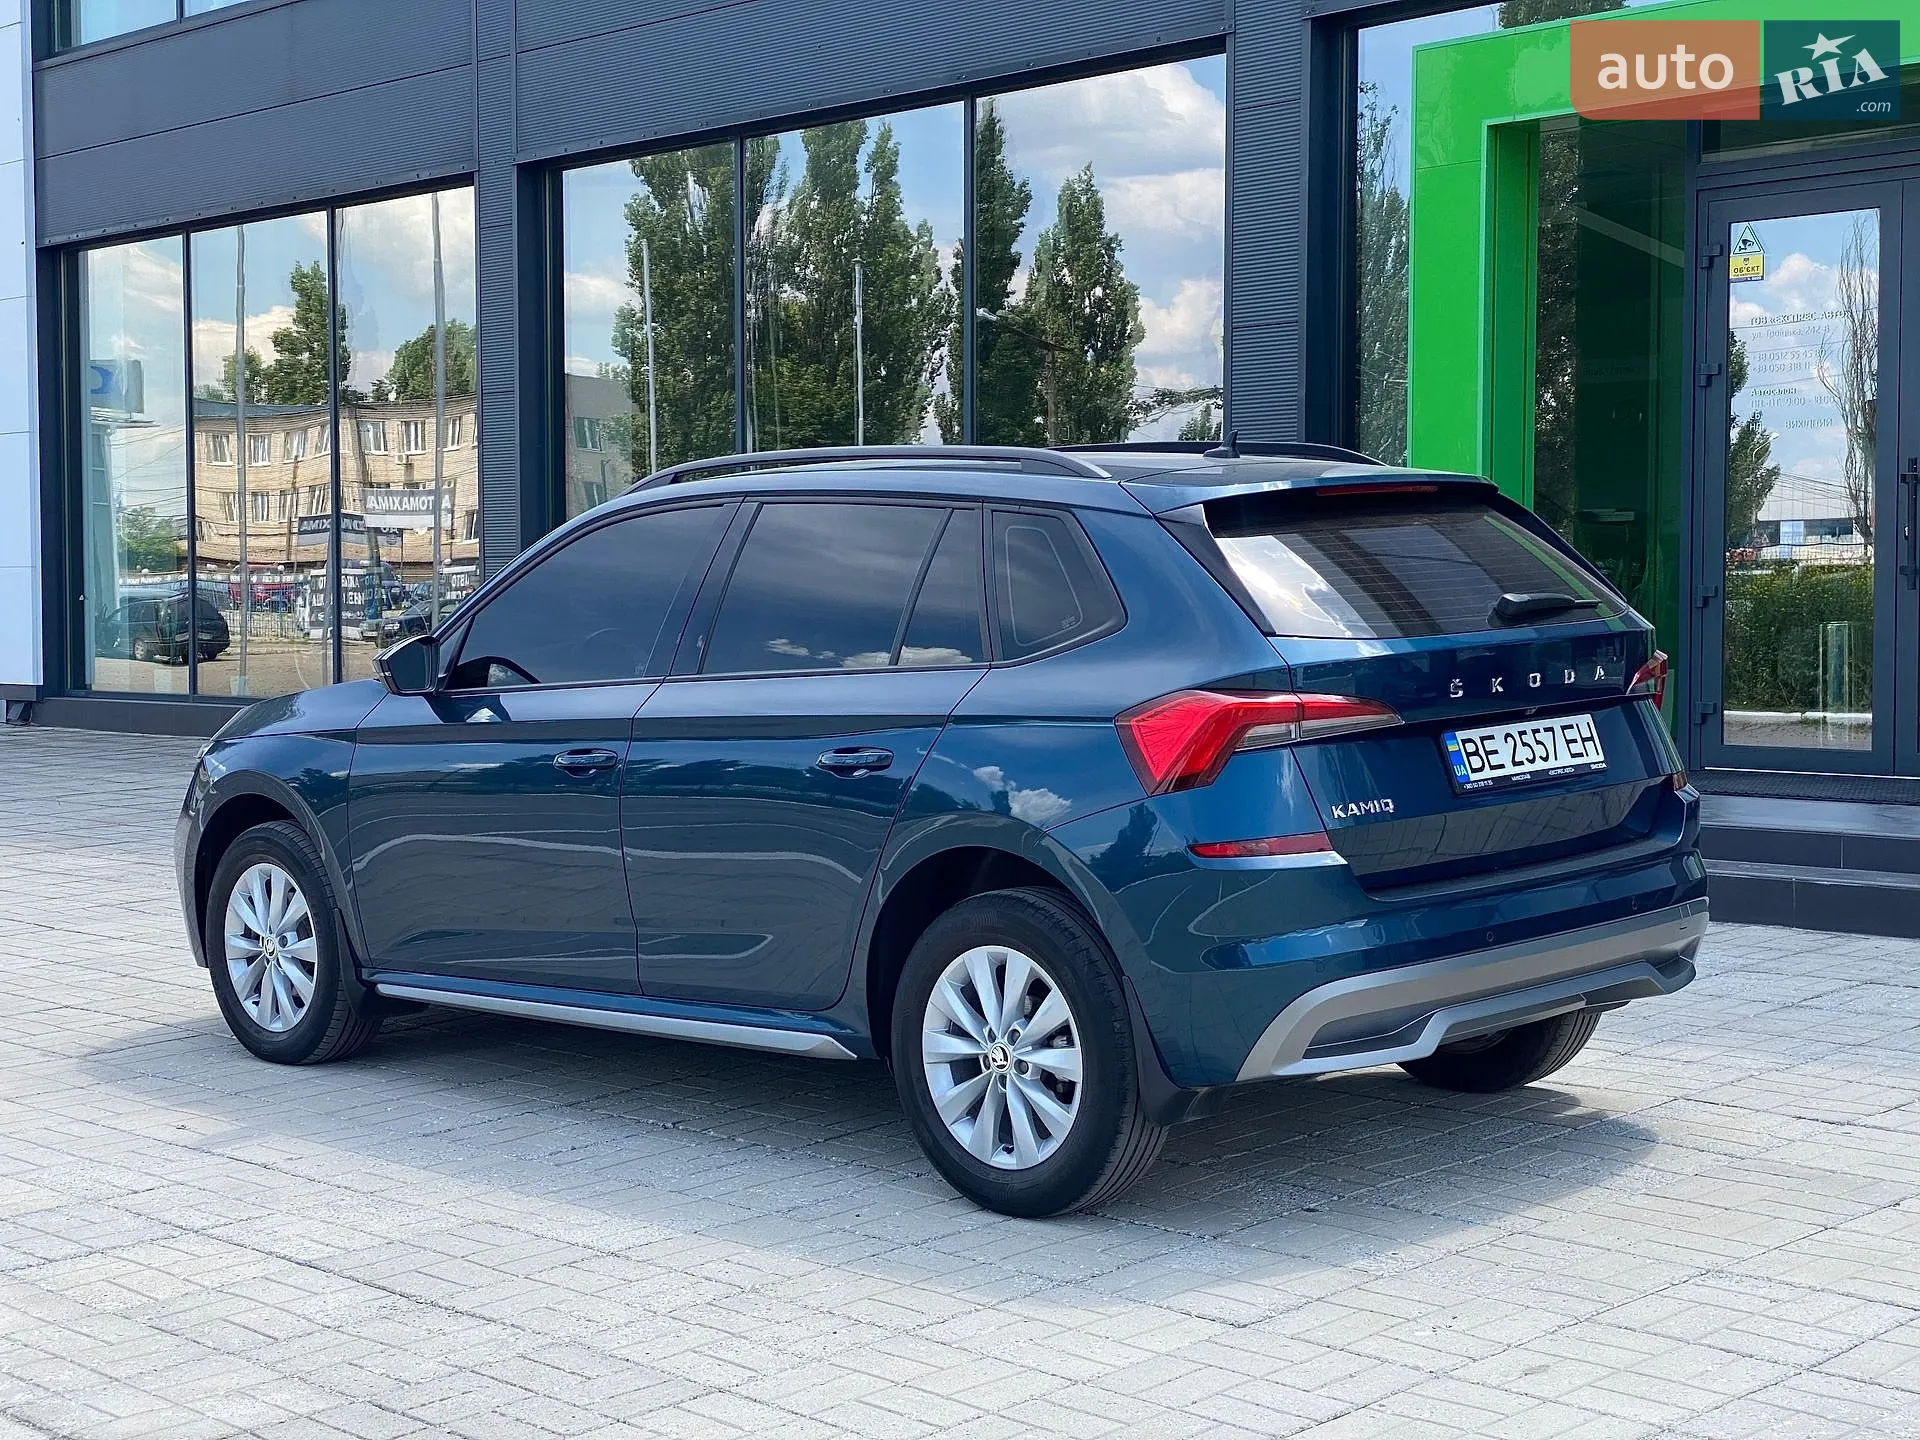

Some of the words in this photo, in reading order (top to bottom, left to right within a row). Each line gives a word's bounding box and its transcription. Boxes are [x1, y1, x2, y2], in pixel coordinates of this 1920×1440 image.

[1733, 265, 1760, 274] ОБ'ЄКТ
[1751, 316, 1768, 326] ТОВ
[1450, 665, 1605, 698] ŠKODA
[1460, 734, 1506, 774] BE
[1503, 726, 1559, 768] 2557
[1560, 721, 1600, 759] EH
[1453, 764, 1468, 777] UA
[1331, 798, 1395, 819] KAMIQ
